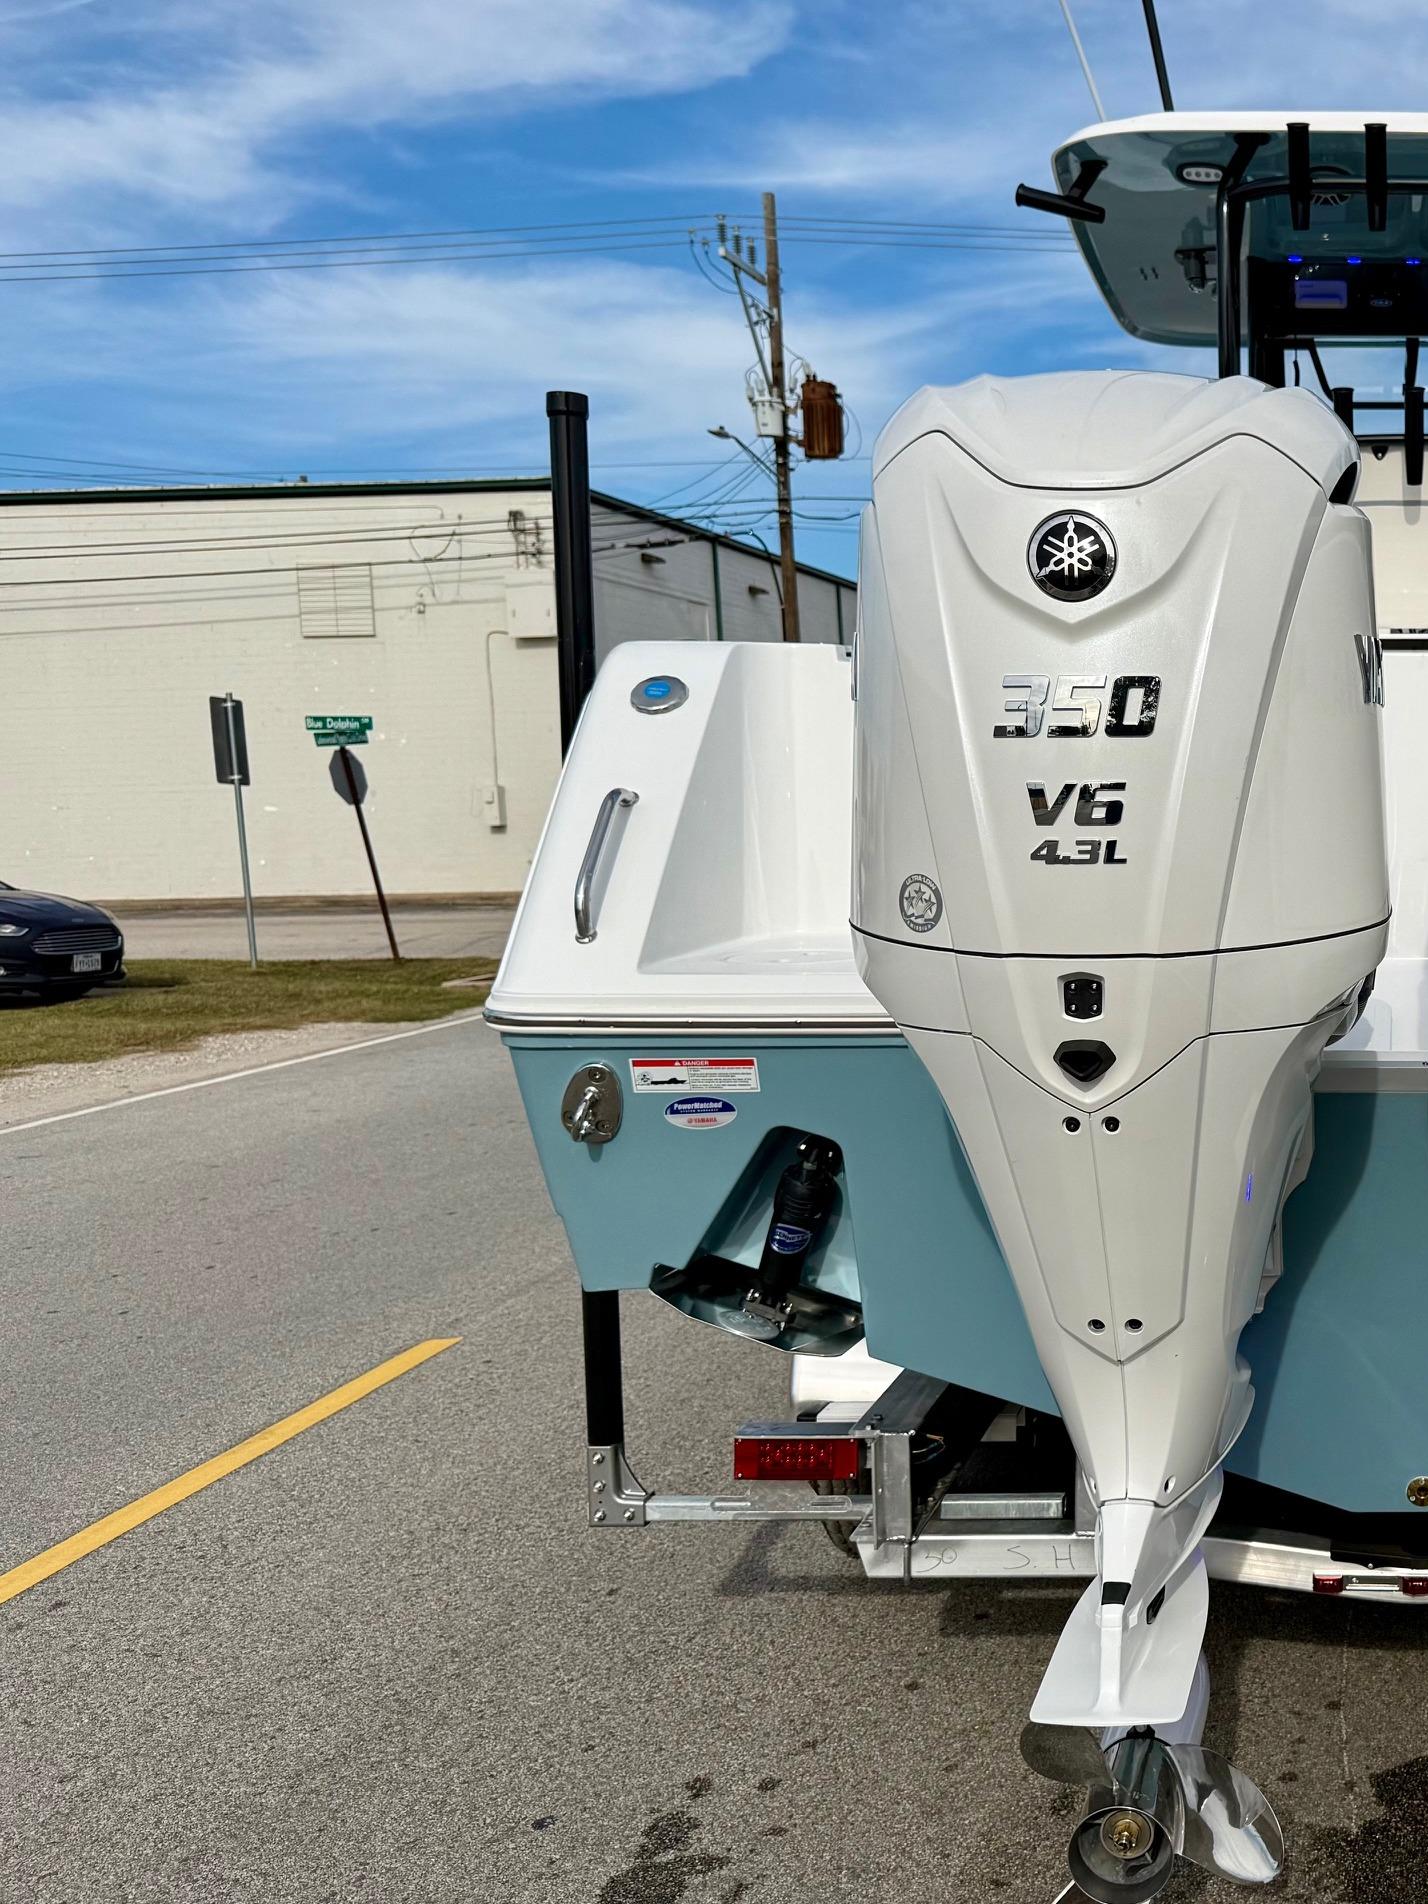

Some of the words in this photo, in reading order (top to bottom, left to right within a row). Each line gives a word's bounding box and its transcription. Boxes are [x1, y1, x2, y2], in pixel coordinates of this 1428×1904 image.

[993, 674, 1162, 738] 350
[306, 717, 322, 729] Blue
[327, 717, 360, 730] Dolphin
[1026, 782, 1127, 826] V6
[1030, 839, 1127, 865] 4.3L
[673, 1101, 723, 1110] PowerMatched
